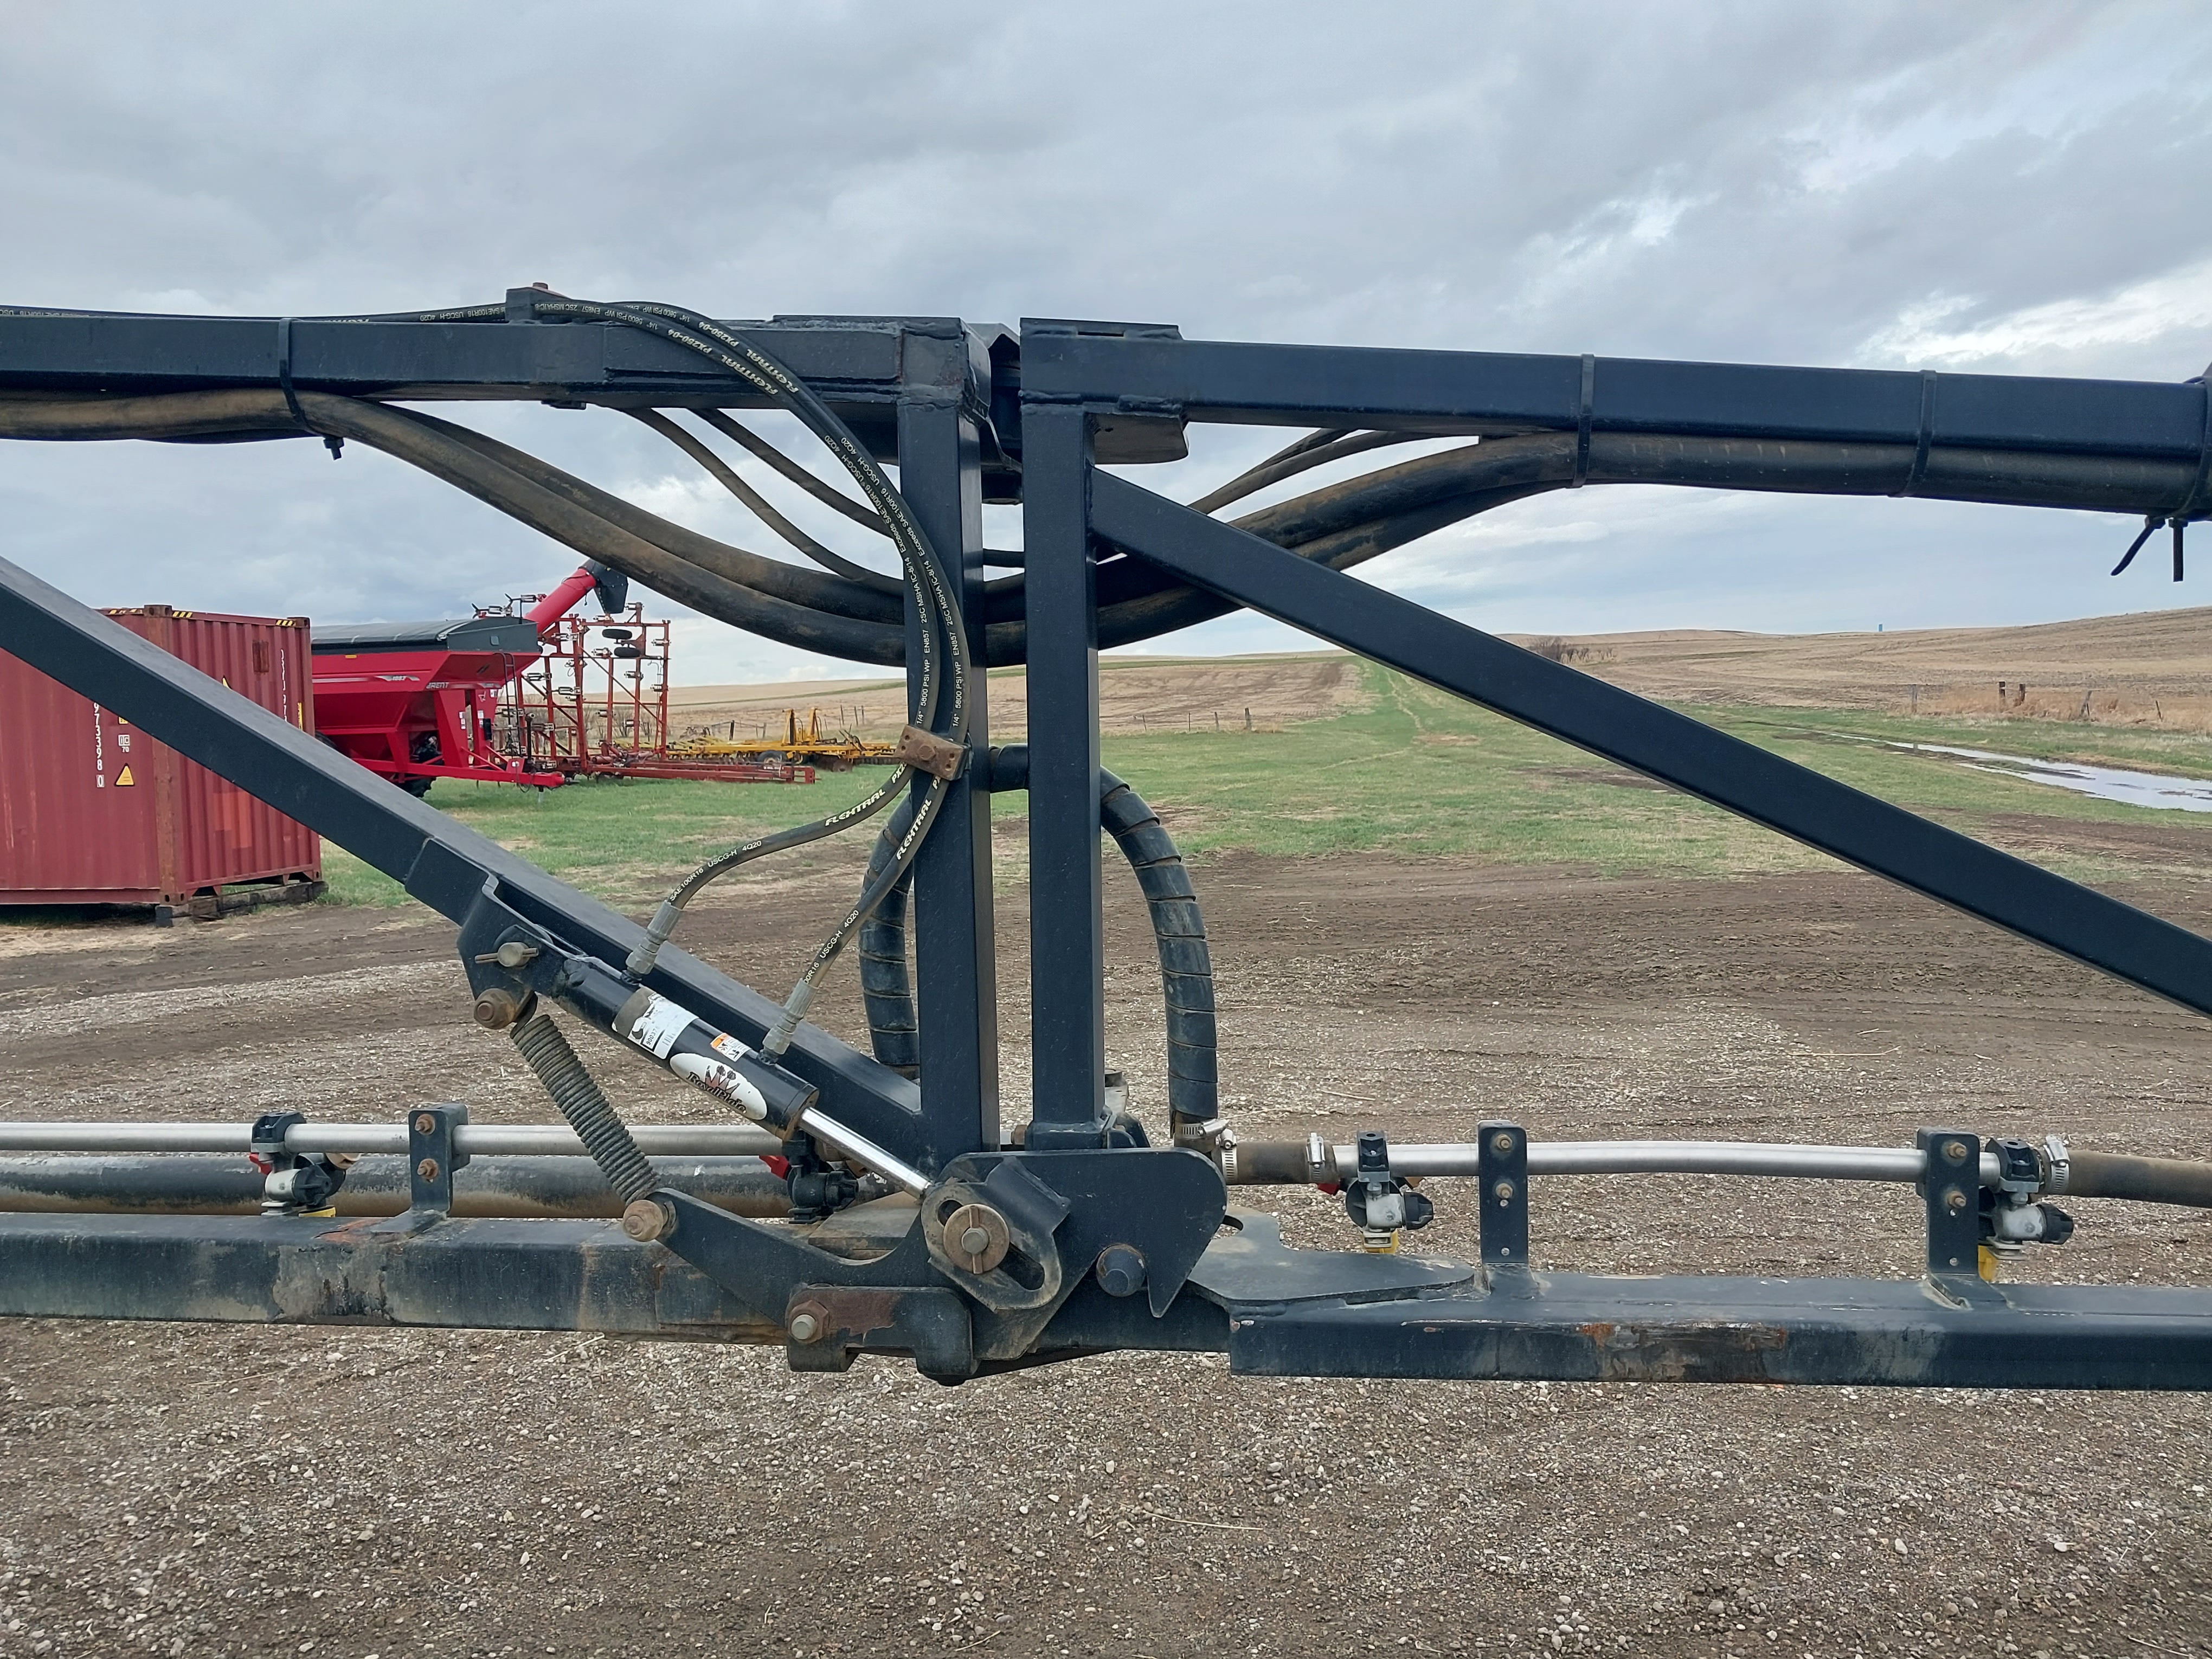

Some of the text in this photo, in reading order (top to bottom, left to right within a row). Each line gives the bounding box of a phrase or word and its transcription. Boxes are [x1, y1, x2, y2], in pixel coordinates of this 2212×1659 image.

[440, 311, 464, 320] USCG-H
[582, 305, 600, 314] EN857
[605, 310, 616, 318] WP
[616, 312, 627, 321] PSI
[667, 328, 713, 355] PX250-04
[698, 321, 740, 347] PX250-04
[824, 434, 840, 453] 4Q20
[841, 437, 858, 455] 4Q20
[841, 454, 864, 483] USCG-H
[857, 456, 881, 487] USCG-H
[865, 484, 892, 524] SAE100R16
[880, 487, 909, 529] SAE100R16
[889, 523, 906, 554] Exceeds
[906, 526, 925, 557] Exceeds
[904, 557, 919, 583] IC-8/14
[923, 560, 940, 587] IC-8/14
[914, 583, 925, 608] MSHA
[935, 586, 948, 610] MSHA
[919, 607, 928, 623] 2SC
[942, 610, 954, 626] 2SC
[949, 632, 960, 656] EN857
[923, 659, 930, 673] WP
[954, 661, 961, 675] WP
[920, 688, 929, 707] 5800
[669, 866, 704, 902] SAE100R16
[707, 848, 737, 868] USCG-H
[742, 840, 762, 852] 4Q20
[825, 788, 886, 826] FLEXTRAL
[819, 929, 844, 959] USCG-H
[844, 909, 859, 928] 4Q20
[896, 798, 933, 860] FLEXTRAL
